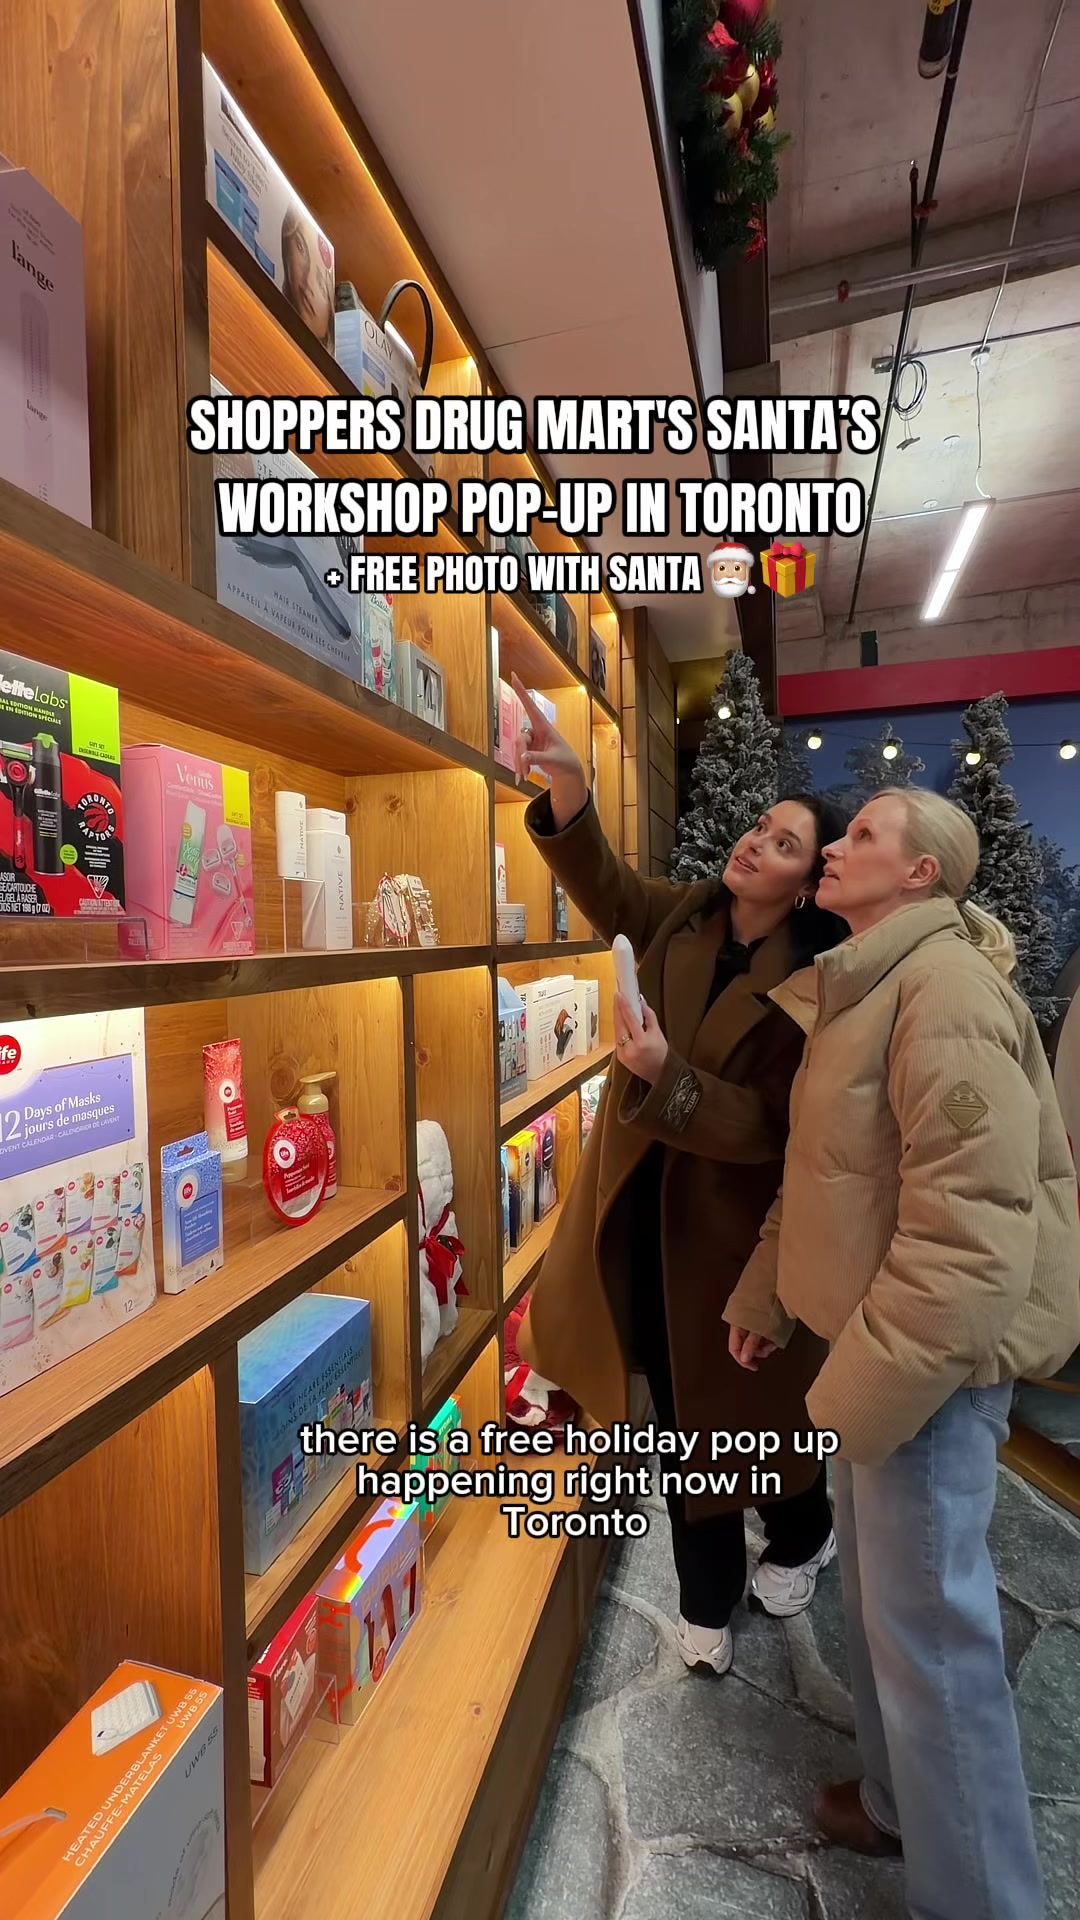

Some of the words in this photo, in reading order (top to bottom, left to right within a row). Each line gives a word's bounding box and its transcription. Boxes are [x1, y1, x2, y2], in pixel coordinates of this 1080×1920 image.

[364, 320, 393, 361] OLAY
[227, 583, 260, 609] APPAREIL
[271, 608, 296, 630] VAPEUR
[297, 624, 314, 640] POUR
[315, 635, 325, 647] LES
[273, 591, 289, 606] HAIR
[292, 602, 318, 624] STEAMER
[10, 700, 33, 711] EDITION
[33, 706, 55, 717] HANDLE
[79, 747, 99, 757] ENSEMBLE
[100, 752, 116, 761] CADEAU
[176, 763, 215, 790] Venus
[77, 793, 114, 815] TORONTO
[78, 820, 115, 841] RAPTORS
[24, 1104, 52, 1121] Days
[54, 1097, 67, 1113] of
[68, 1091, 101, 1110] Masks
[24, 1119, 54, 1140] jours
[56, 1113, 70, 1127] de
[72, 1103, 115, 1124] masques
[22, 1134, 54, 1148] CALENDAR
[57, 1125, 92, 1138] CALENDRIER
[124, 1299, 134, 1313] 12
[288, 1377, 320, 1413] SKINCARE
[321, 1345, 353, 1381] ESSENTIALS
[177, 1704, 198, 1729] UWB
[194, 1691, 208, 1705] 55
[184, 1744, 207, 1779] UWB
[207, 1726, 219, 1745] 55
[62, 1811, 104, 1863] HEATED
[101, 1725, 169, 1811] UNDERBLANKET
[166, 1700, 188, 1725] UWB
[183, 1688, 198, 1702] 55
[74, 1753, 163, 1867] CHAUFFE-MATELAS
